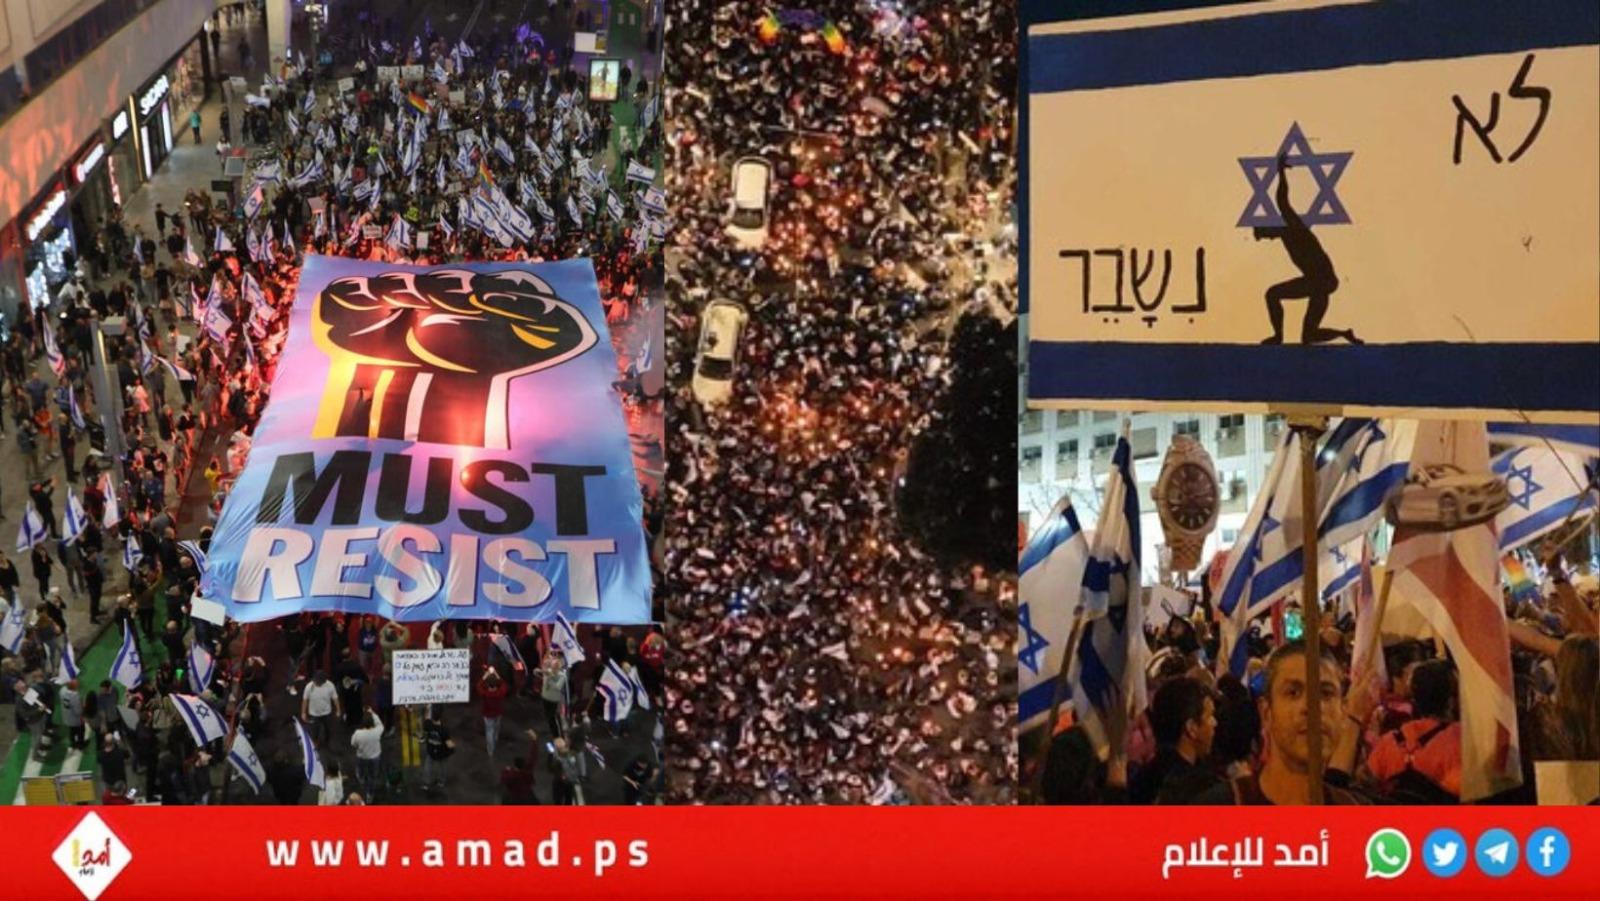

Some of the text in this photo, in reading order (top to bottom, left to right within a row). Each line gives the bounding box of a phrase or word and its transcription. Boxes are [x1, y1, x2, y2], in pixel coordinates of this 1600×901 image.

[1452, 54, 1551, 164] לא
[257, 450, 606, 536] MUST
[231, 523, 616, 610] RESIST
